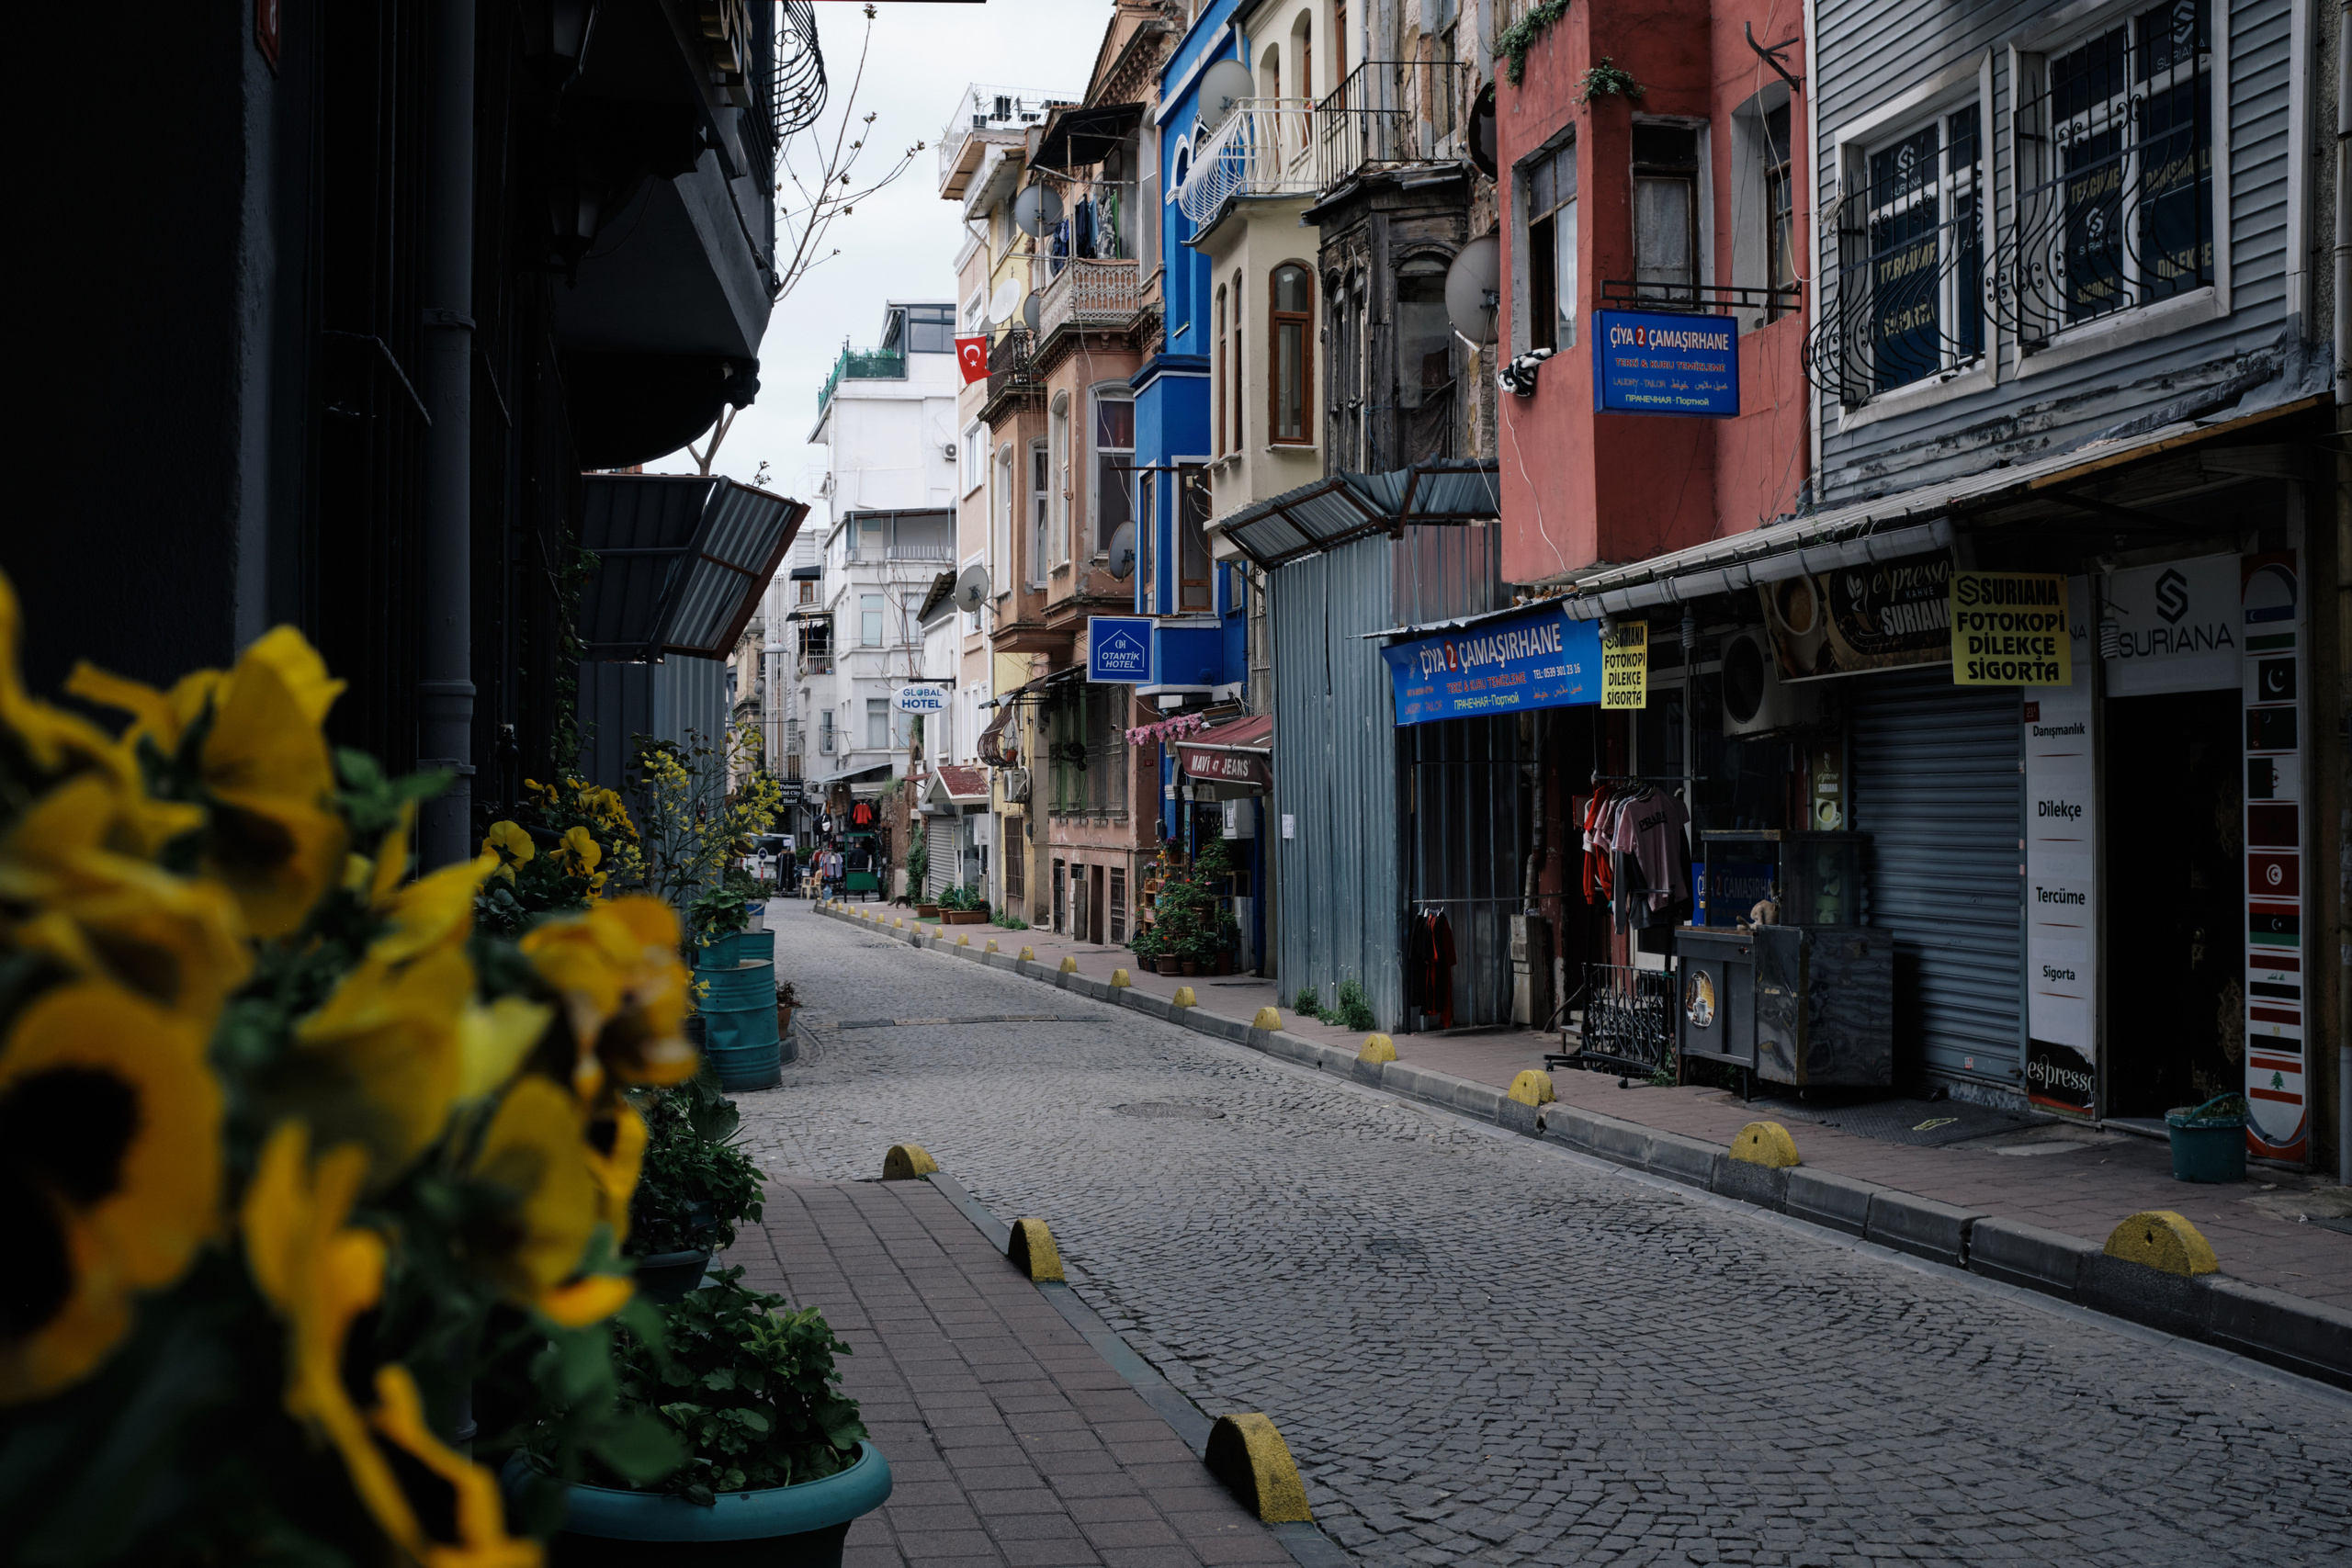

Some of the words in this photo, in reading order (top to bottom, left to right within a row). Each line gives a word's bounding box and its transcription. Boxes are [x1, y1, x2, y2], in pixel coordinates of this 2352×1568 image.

[1610, 323, 1634, 349] ÇİYA
[1637, 328, 1645, 345] 2
[1648, 329, 1729, 353] ÇAMAŞIRHANE
[1615, 357, 1639, 368] TERZİ
[1641, 359, 1648, 368] &
[1650, 359, 1675, 370] KURU
[1677, 359, 1726, 373] TEMİZLEME
[1644, 378, 1666, 388] TAILOR
[1871, 559, 1950, 603] espresso
[1980, 578, 2060, 605] SURIANA
[1905, 586, 1935, 599] KAHVE
[1956, 610, 2065, 633] FOTOKOPİ
[1968, 632, 2056, 660] DİLEKÇE
[2119, 623, 2234, 658] SURIANA
[1102, 651, 1140, 660] OTANTİK
[1419, 645, 1447, 682] ÇİYA
[1446, 644, 1457, 669] 2
[1458, 623, 1563, 675] ÇAMAŞIRHANE
[1604, 649, 1645, 670] FOTOKOPİ
[1105, 660, 1136, 669] HOTEL
[1533, 669, 1544, 679] TEL:
[1967, 657, 2060, 682] SİGORTA
[1446, 679, 1463, 694] TERZİ
[1464, 680, 1469, 693] &
[1469, 678, 1487, 692] KURU
[1487, 671, 1527, 688] TEMİZLEME
[1609, 669, 1642, 690] DİLEKÇE
[903, 688, 943, 697] GLOBAL
[1607, 688, 1643, 706] SİGORTA
[902, 699, 943, 708] HOTEL
[2033, 722, 2086, 739] Danışmanlık
[2039, 801, 2081, 822] Dilekçe
[1724, 875, 1772, 904] ÇAMAŞIRHA
[2036, 886, 2085, 905] Tercüme
[2042, 965, 2075, 981] Sigorta
[2027, 1054, 2095, 1090] espresso
